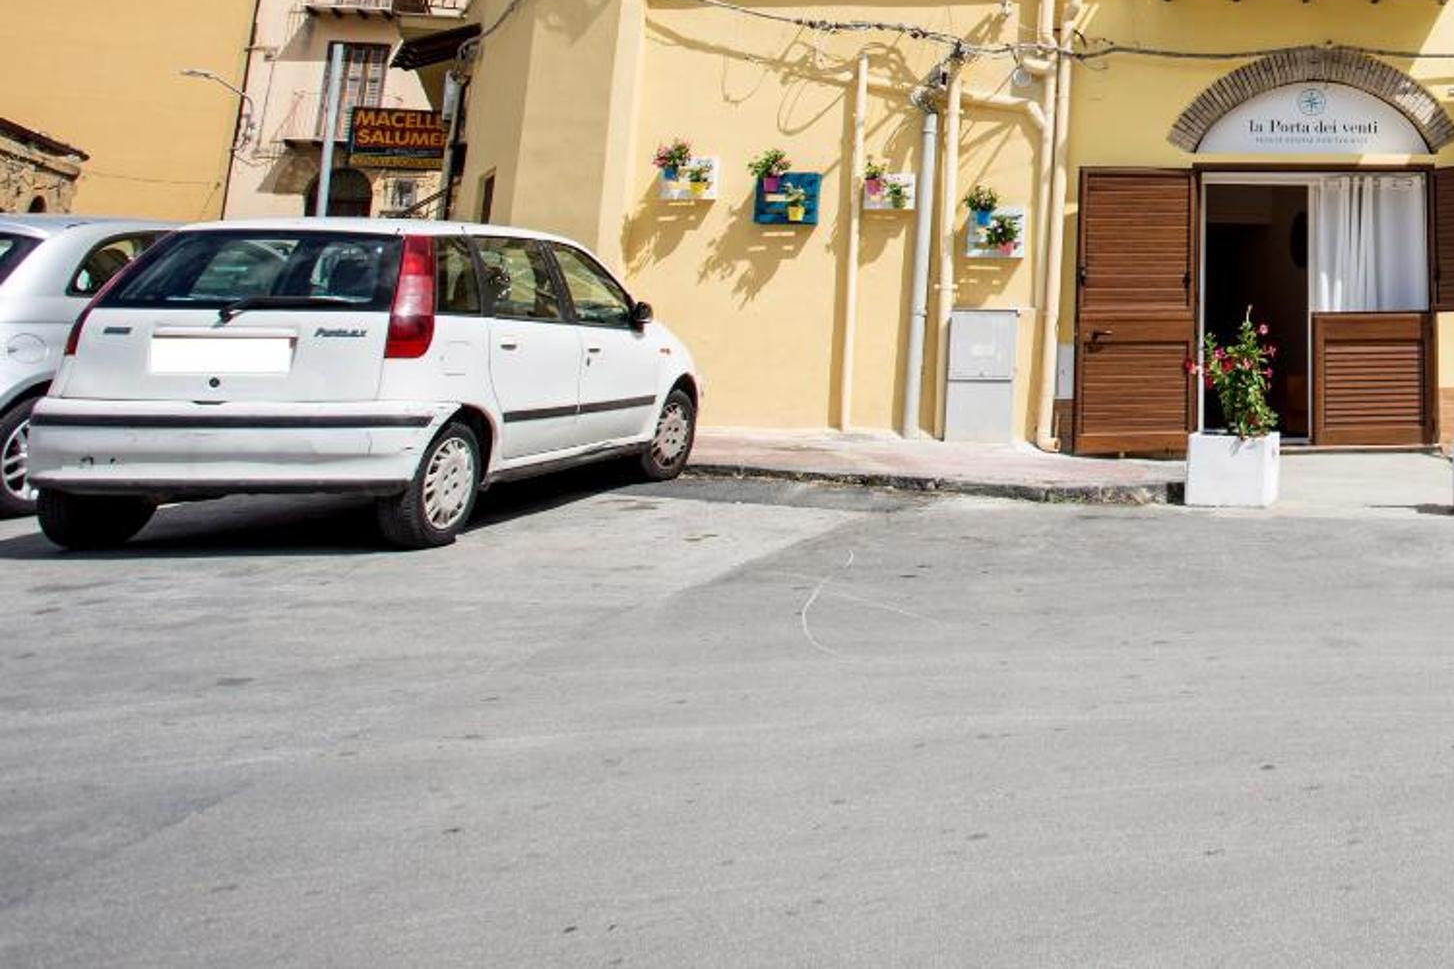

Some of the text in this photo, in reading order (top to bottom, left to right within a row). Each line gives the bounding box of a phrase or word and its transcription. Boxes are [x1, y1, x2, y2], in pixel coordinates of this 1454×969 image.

[1270, 119, 1310, 134] Porta
[1314, 120, 1337, 134] dei
[1342, 121, 1378, 134] venti
